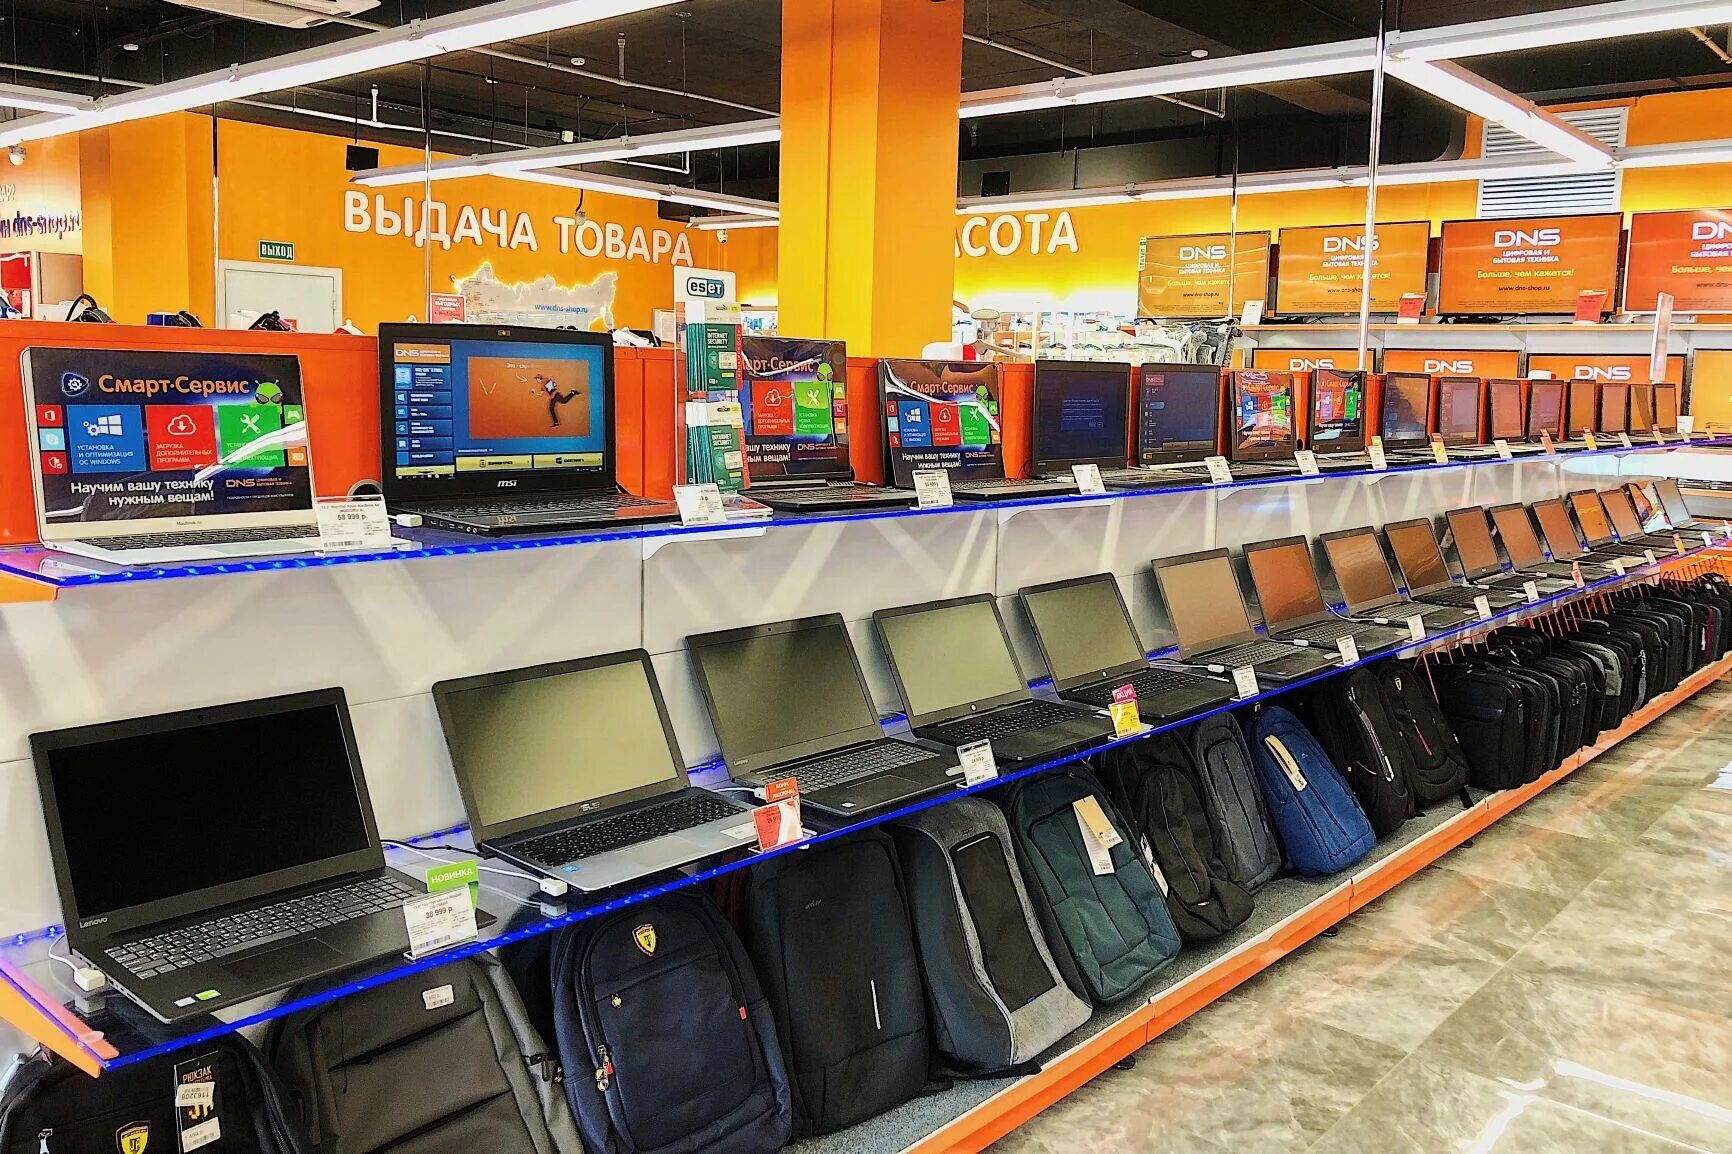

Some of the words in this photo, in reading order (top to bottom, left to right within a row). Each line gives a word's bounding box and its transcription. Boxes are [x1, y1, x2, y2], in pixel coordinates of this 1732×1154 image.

[344, 190, 538, 252] ВЫДАЧА
[554, 215, 694, 267] ТОВАРА
[955, 211, 1079, 258] СОТА
[1692, 221, 1732, 241] DN
[1323, 235, 1380, 253] DNS
[1494, 228, 1561, 248] DNS
[261, 244, 294, 260] ВЫХОД
[1179, 245, 1227, 261] DNS
[1477, 270, 1512, 278] Больше,
[1534, 268, 1575, 277] кажется!
[534, 303, 588, 314] www.dns-shop.ru
[395, 349, 420, 357] DNS
[1289, 358, 1334, 370] DNS
[1424, 359, 1473, 374] DNS
[1574, 366, 1631, 380] DNS
[762, 443, 791, 453] технику
[797, 443, 815, 451] DNS
[763, 453, 791, 463] вещам!
[70, 480, 124, 497] Научим
[127, 480, 162, 494] вашу
[164, 478, 214, 492] технику
[225, 478, 255, 488] DNS
[497, 479, 518, 488] msi
[108, 494, 164, 508] нужным
[167, 490, 215, 506] вещам!
[431, 867, 474, 884] НОВИНКА
[434, 907, 447, 917] 999
[79, 916, 108, 929] Lenovo
[182, 1064, 212, 1084] РЮКЗАК
